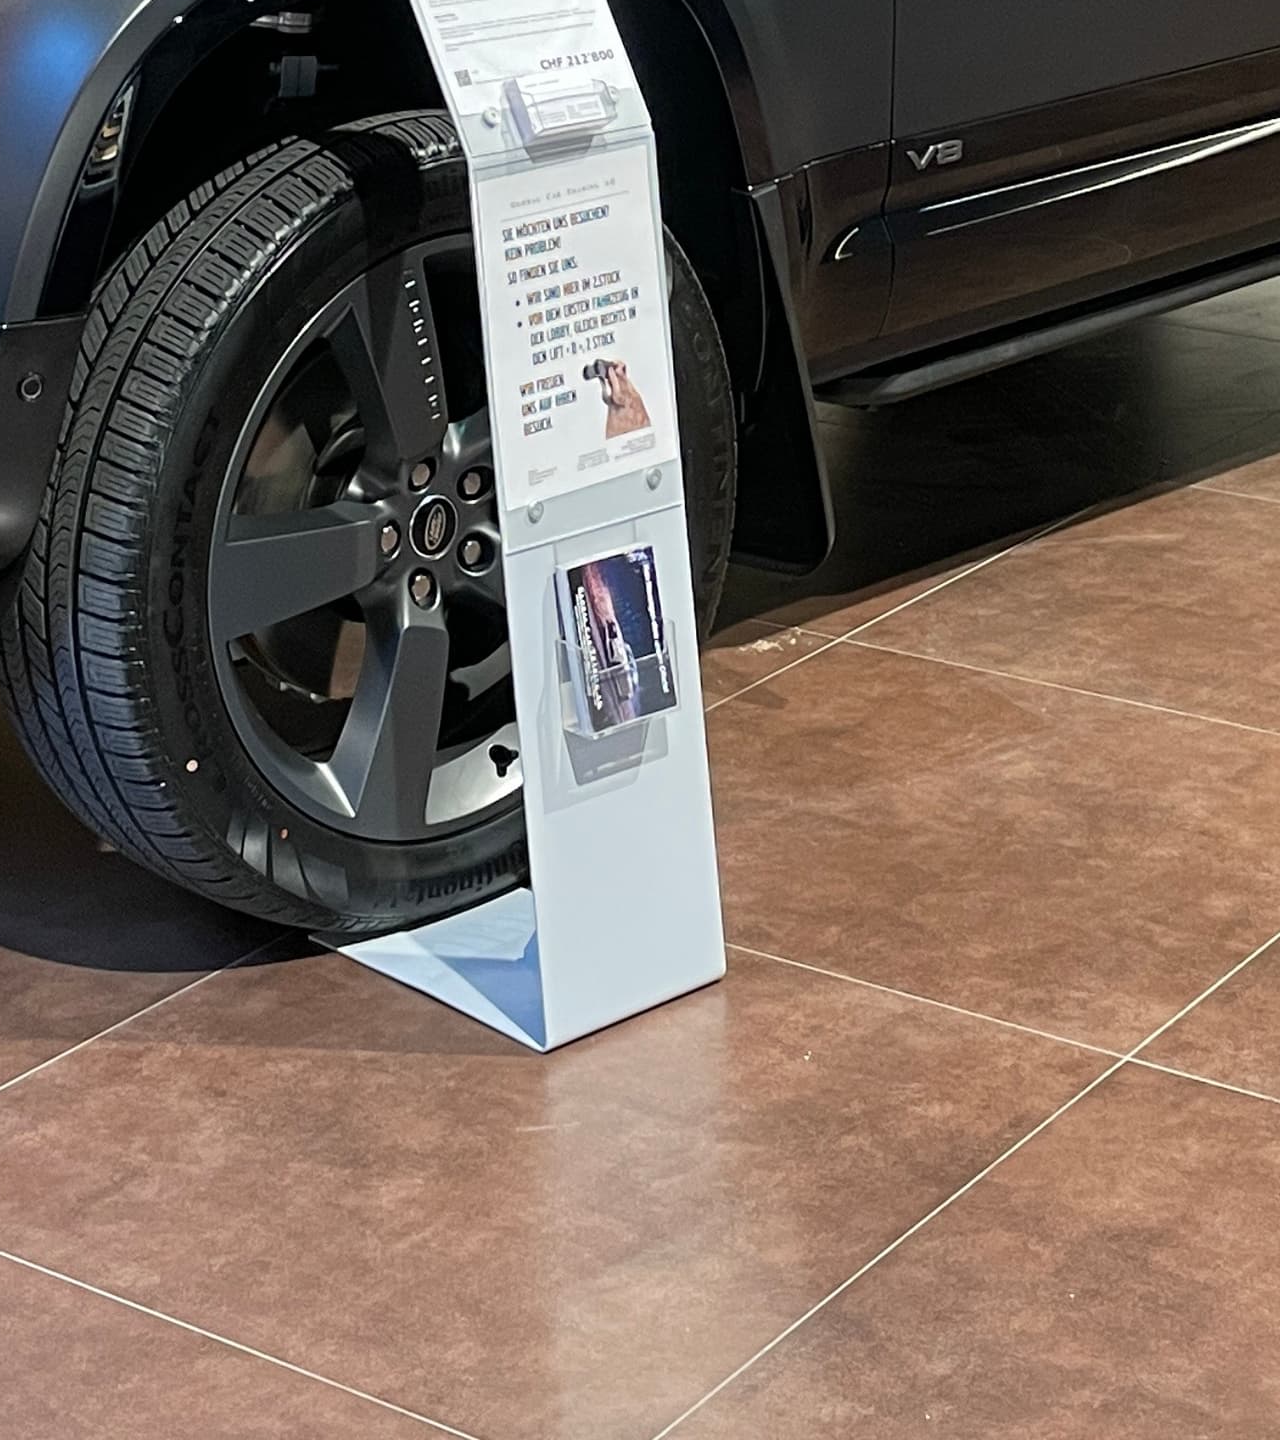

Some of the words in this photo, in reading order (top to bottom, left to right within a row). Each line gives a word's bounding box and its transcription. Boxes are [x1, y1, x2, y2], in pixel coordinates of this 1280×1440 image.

[540, 57, 563, 70] CHF
[905, 140, 963, 171] V8
[502, 228, 514, 243] SIE
[553, 215, 569, 230] UNS
[549, 345, 564, 361] LIFT
[592, 331, 616, 349] STOCK
